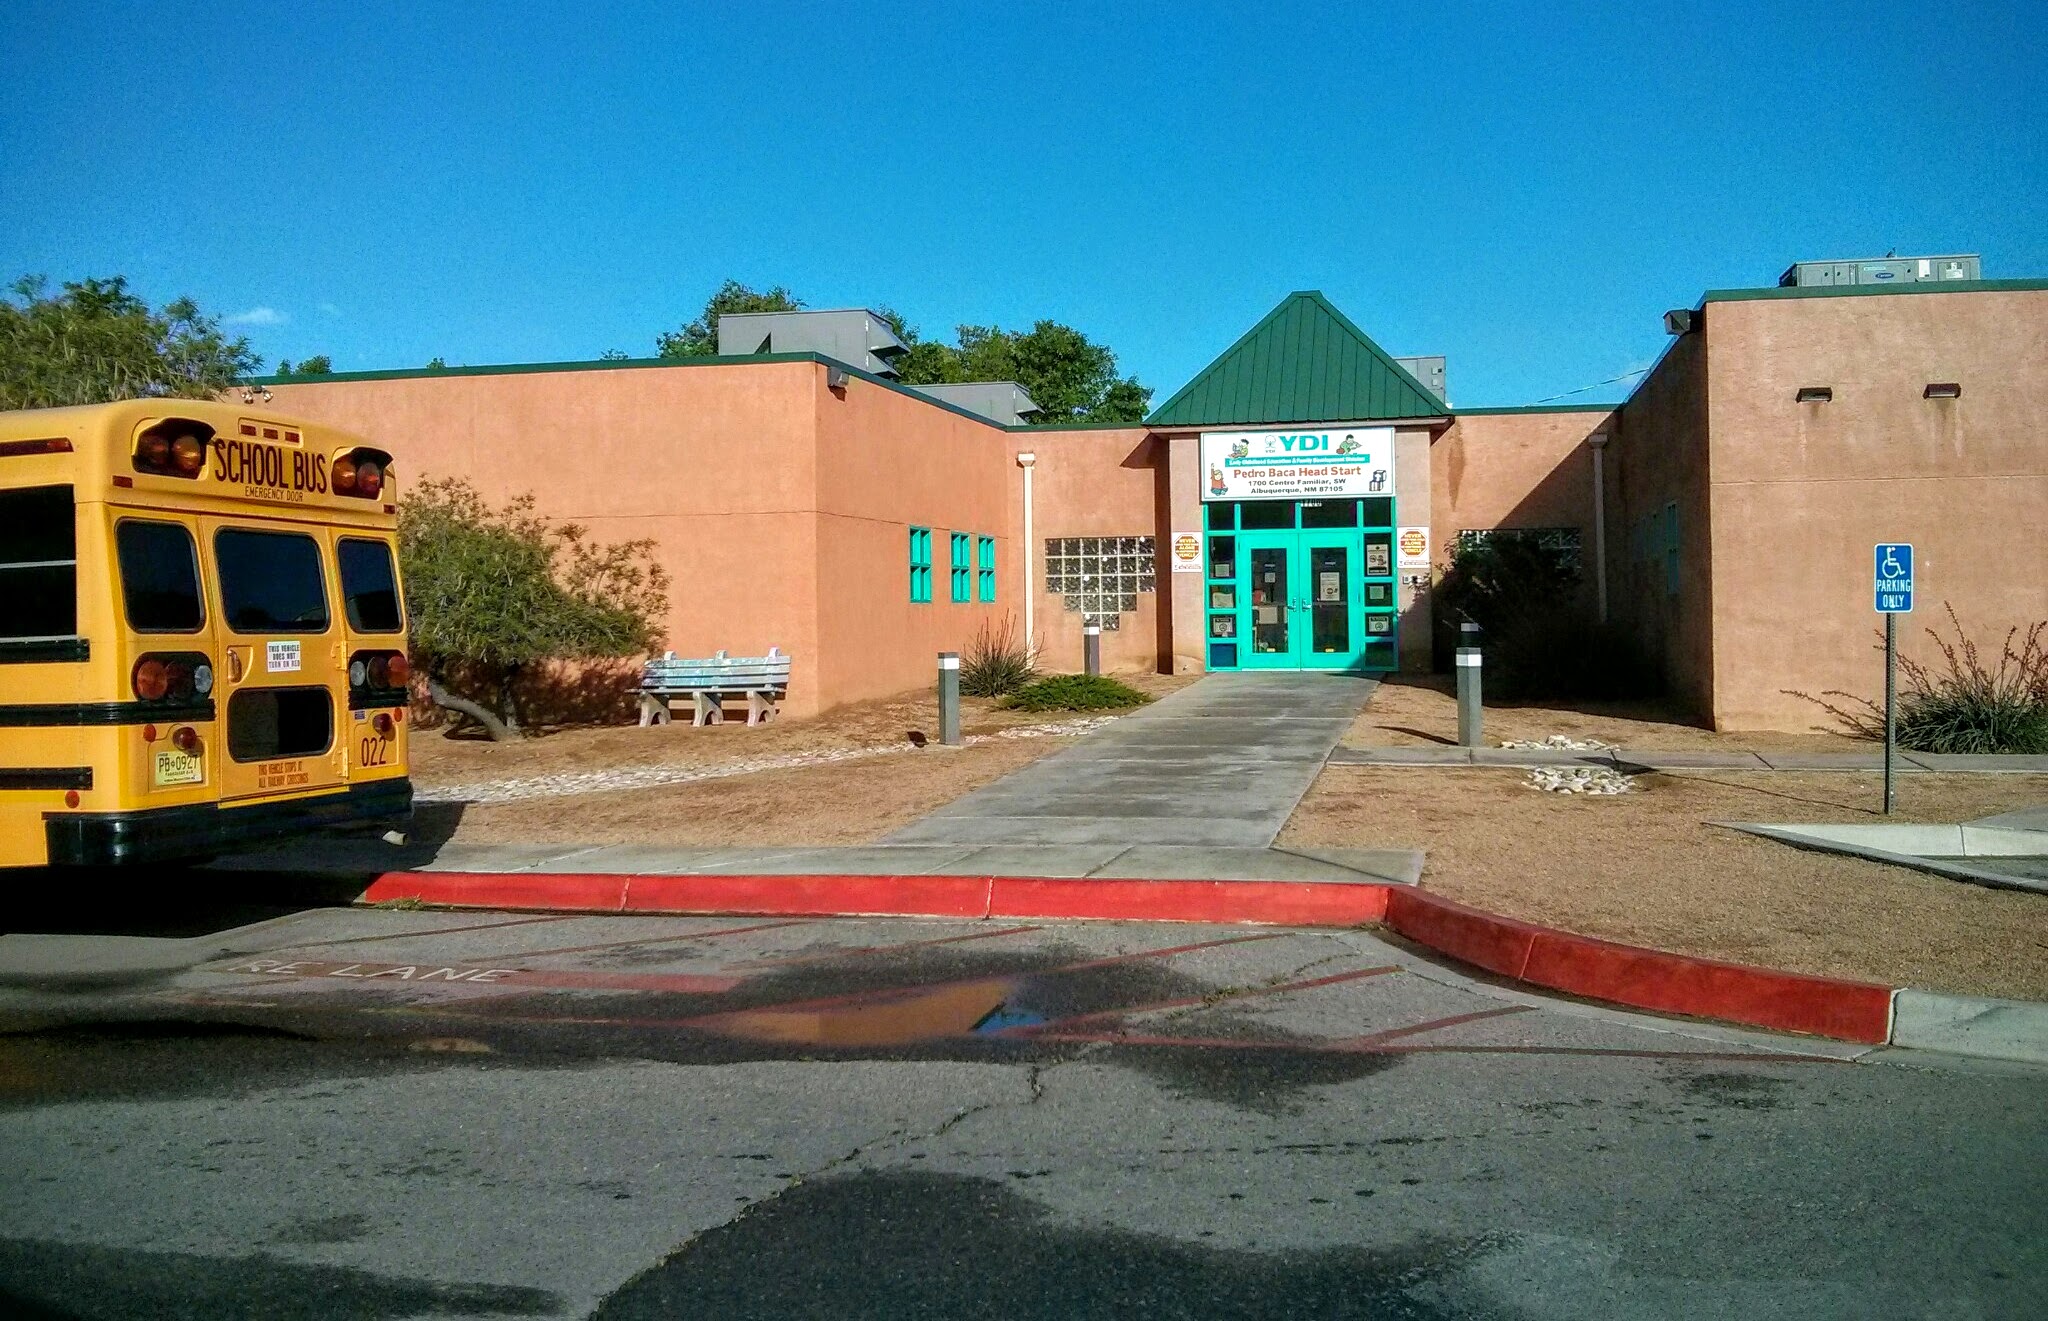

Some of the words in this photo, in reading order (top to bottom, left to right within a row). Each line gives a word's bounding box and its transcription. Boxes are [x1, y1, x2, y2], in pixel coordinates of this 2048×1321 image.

[1278, 435, 1329, 451] YDI
[214, 438, 289, 489] SCHOOL
[293, 450, 328, 494] BUS
[1233, 469, 1266, 478] Pedro
[1268, 468, 1296, 477] Baca
[1298, 467, 1328, 477] Head
[1330, 466, 1362, 476] Start
[245, 486, 284, 500] EMERGENCY
[286, 490, 304, 502] DOOR
[1250, 487, 1302, 495] Albuquerque,
[1876, 579, 1911, 592] PARKING
[1882, 594, 1905, 608] ONLY
[268, 645, 279, 653] THIS
[361, 736, 387, 767] 022
[328, 964, 519, 982] LANE
